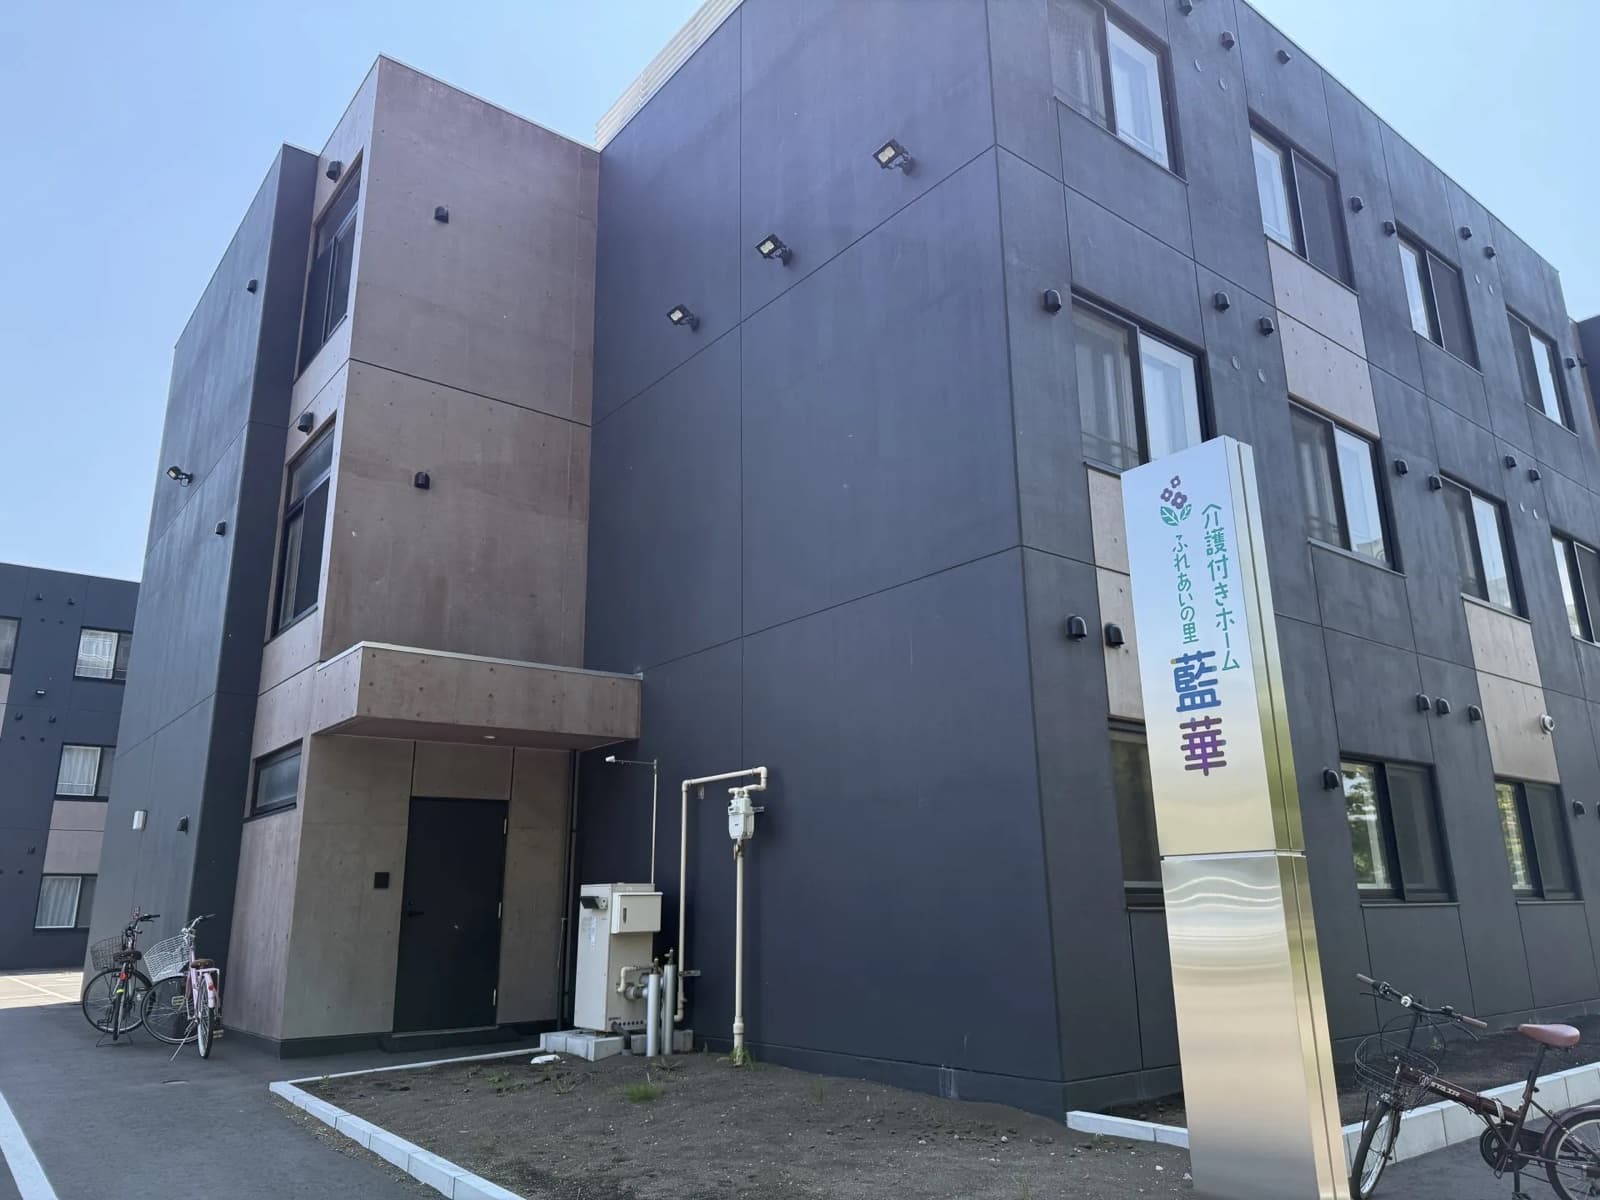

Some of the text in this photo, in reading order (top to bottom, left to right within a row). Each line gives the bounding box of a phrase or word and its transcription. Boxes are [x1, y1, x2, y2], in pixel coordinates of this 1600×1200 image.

[1172, 535, 1199, 644] ふれあいの里
[1202, 503, 1240, 671] 介護付きホーム
[1170, 650, 1227, 777] 藍華
